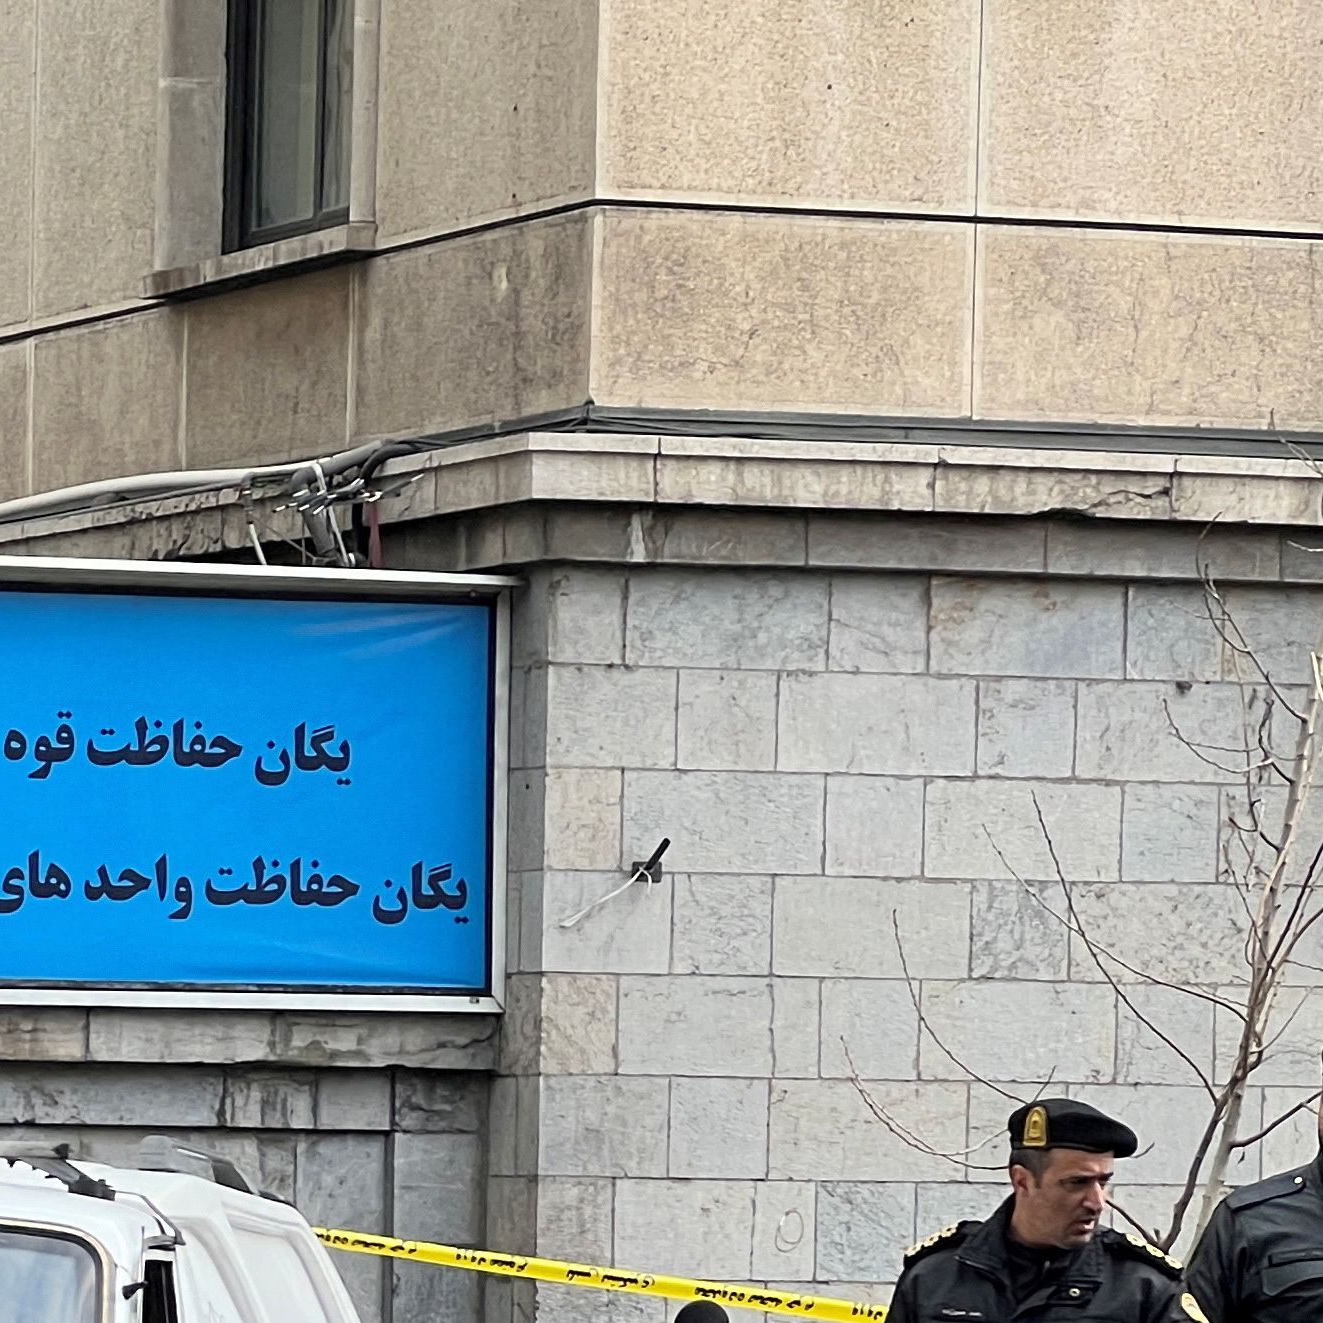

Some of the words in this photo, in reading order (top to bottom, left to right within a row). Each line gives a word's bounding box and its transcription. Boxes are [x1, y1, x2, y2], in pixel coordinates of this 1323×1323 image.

[3, 709, 77, 780] قوه
[87, 715, 244, 769] حفاظت
[255, 720, 352, 786] یگان
[82, 853, 191, 919] واحد
[204, 855, 361, 909] حفاظت
[371, 861, 471, 925] یگان
